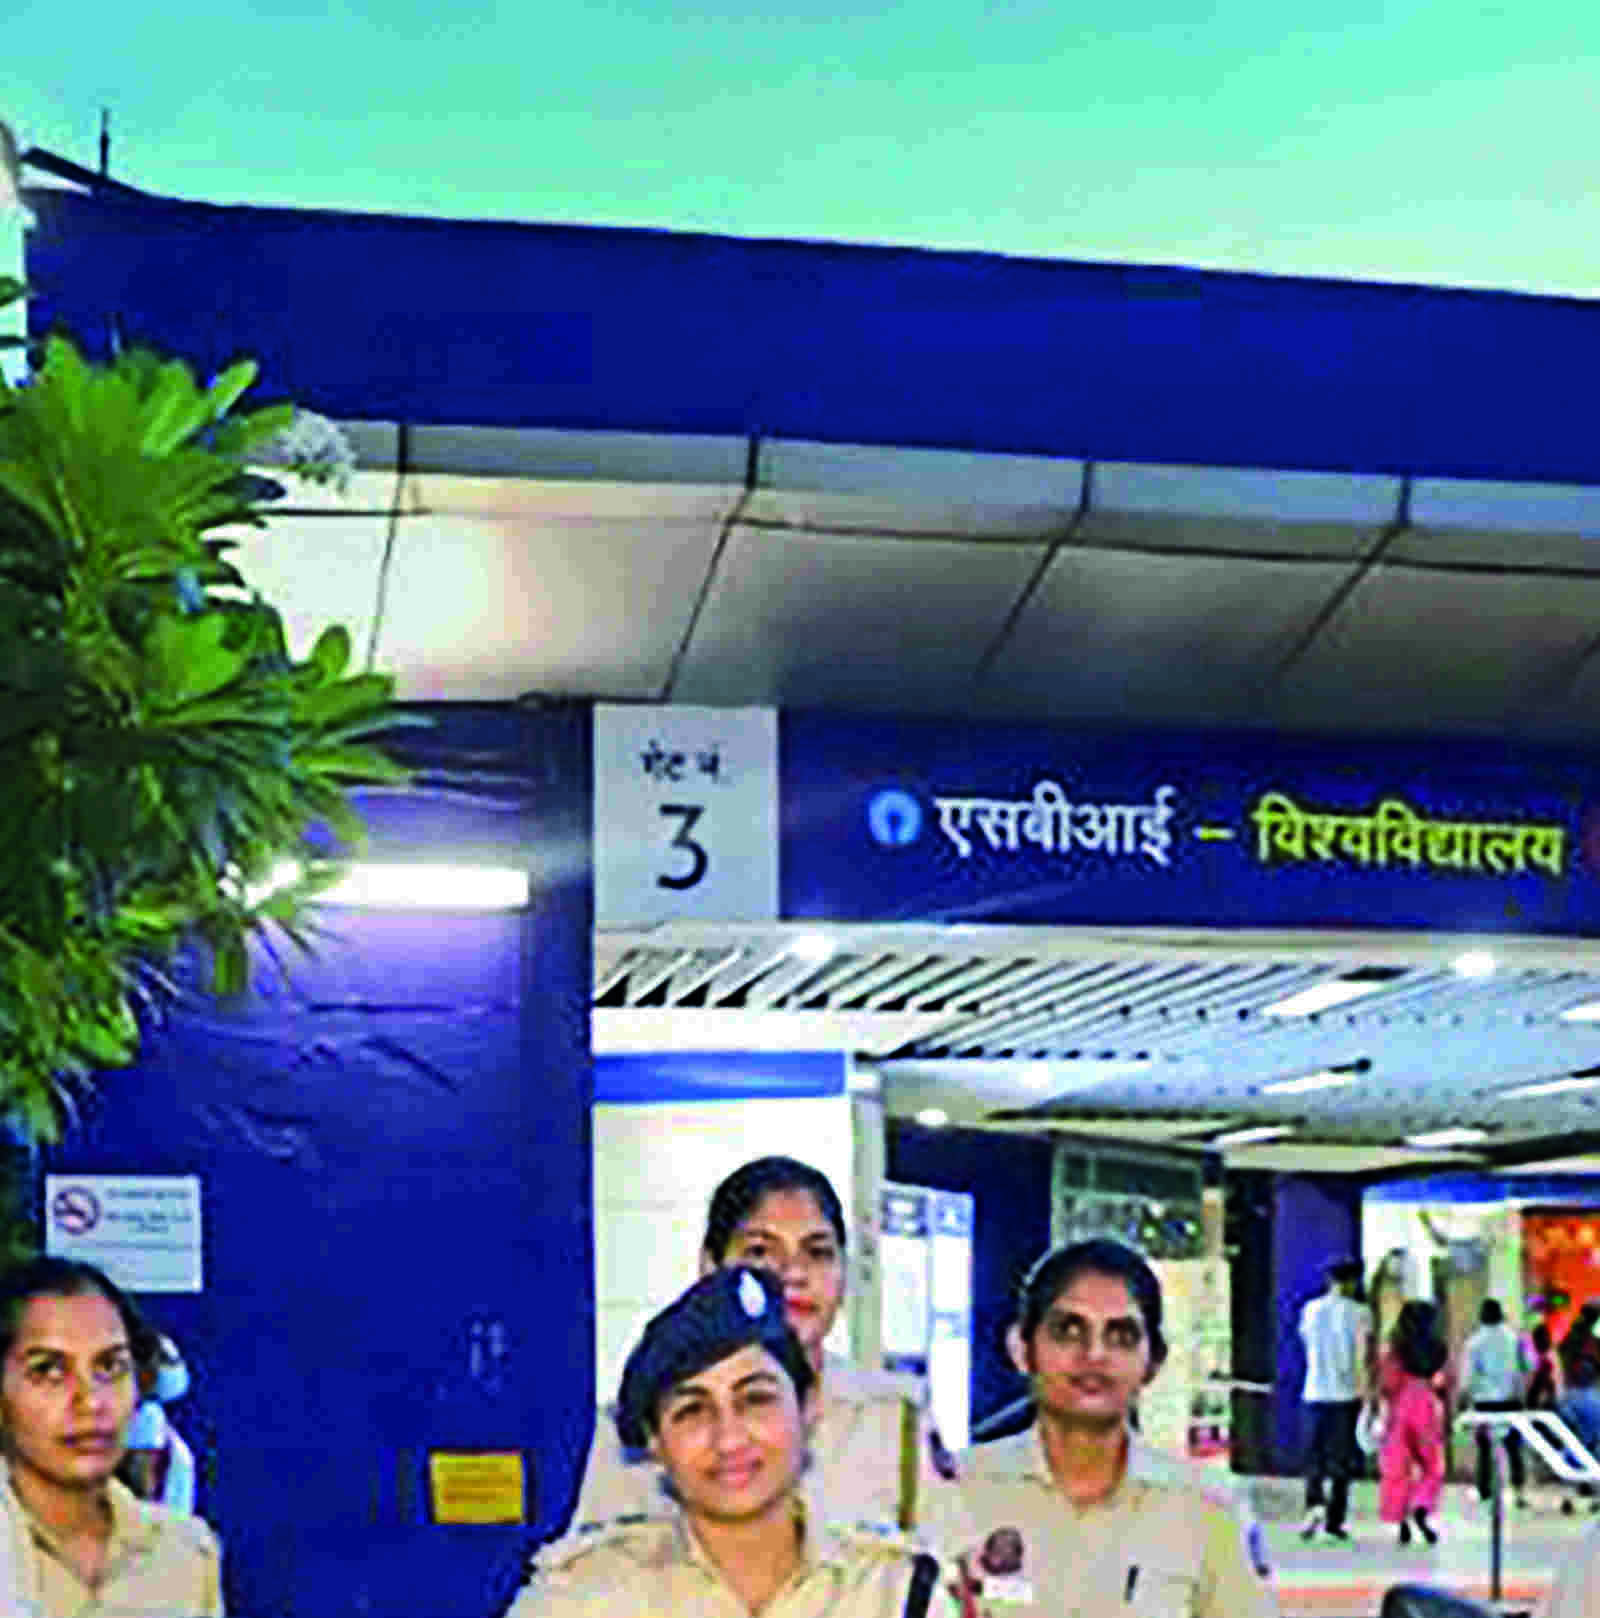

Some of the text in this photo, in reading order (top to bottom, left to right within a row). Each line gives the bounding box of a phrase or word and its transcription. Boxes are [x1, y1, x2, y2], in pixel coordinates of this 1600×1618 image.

[656, 803, 709, 889] 3
[932, 780, 1177, 866] एसबीआई
[1250, 791, 1565, 875] विश्वविद्यालय
